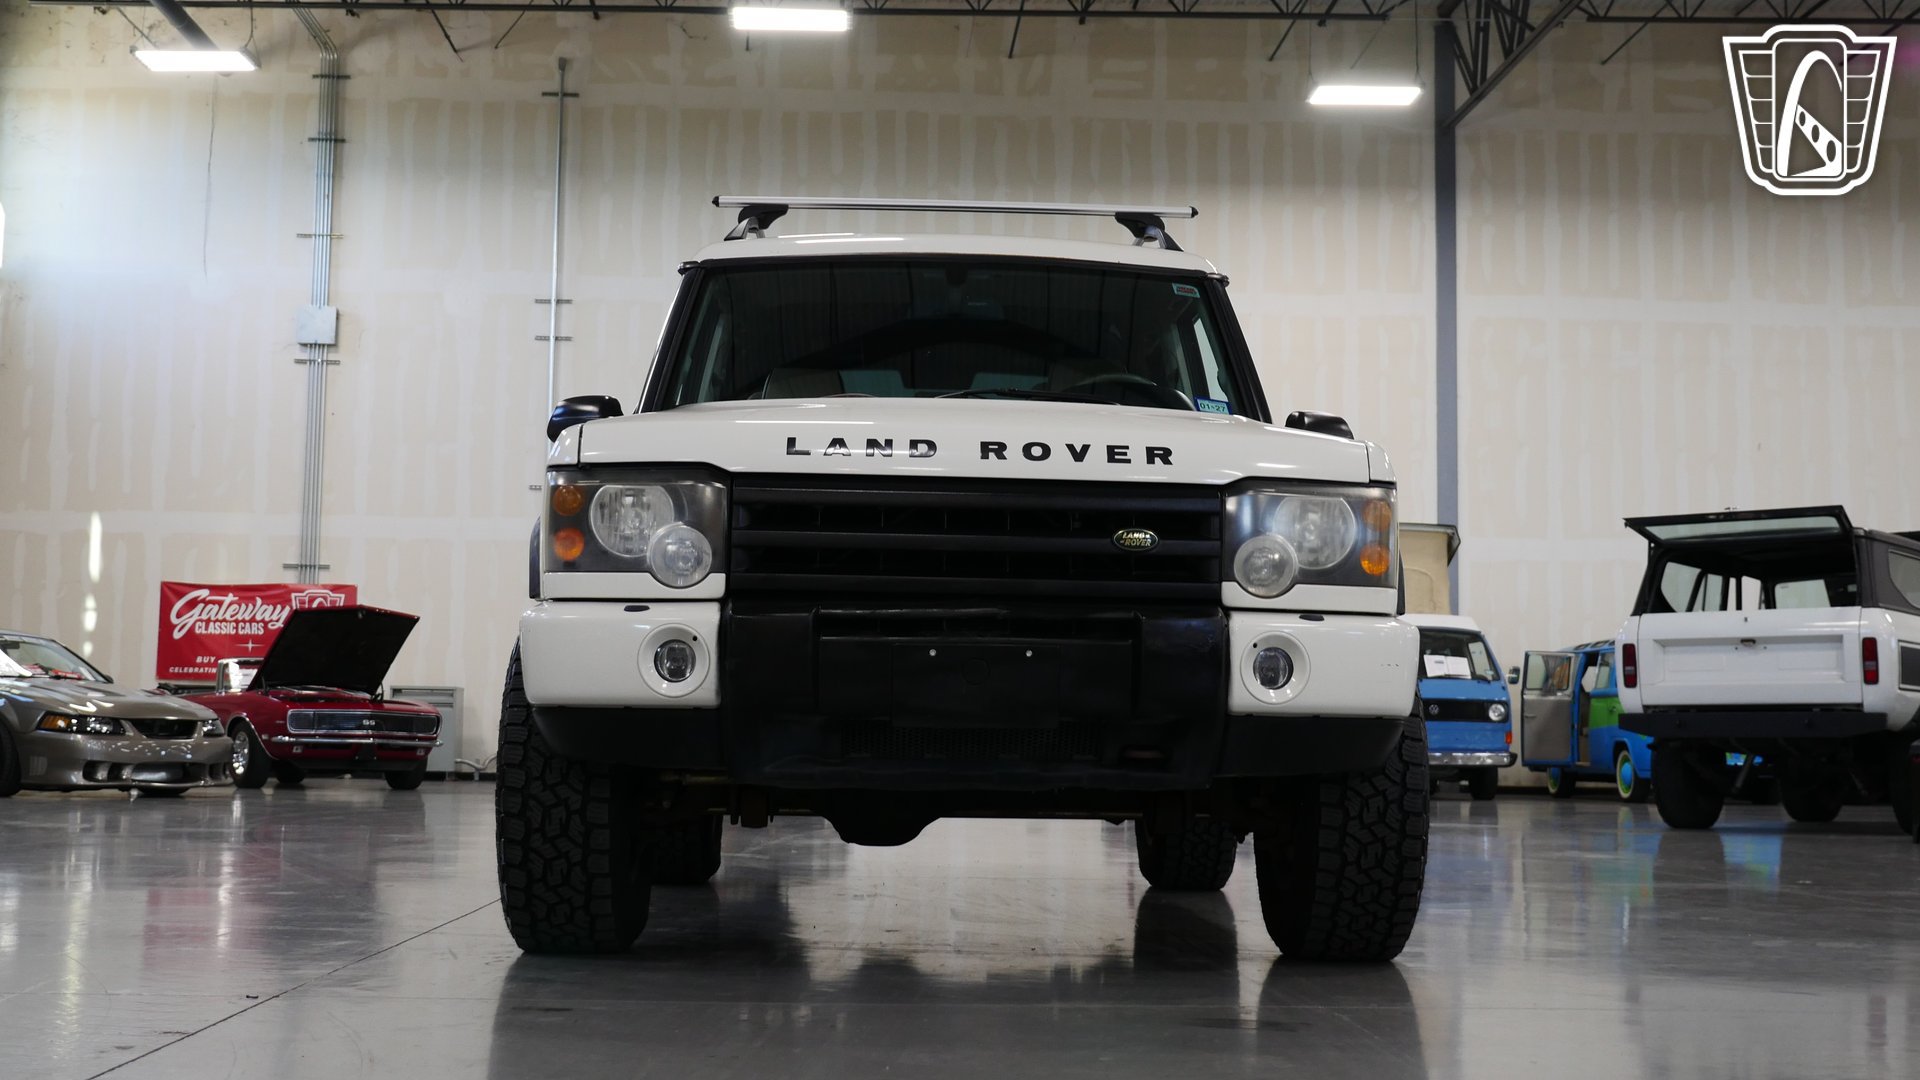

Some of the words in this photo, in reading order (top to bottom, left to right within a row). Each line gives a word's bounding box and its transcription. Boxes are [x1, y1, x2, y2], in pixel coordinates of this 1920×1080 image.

[786, 437, 938, 458] LAND
[980, 441, 1173, 465] ROVER
[170, 589, 290, 639] Gateway
[195, 622, 236, 634] CLASSIC
[238, 622, 265, 635] CARS
